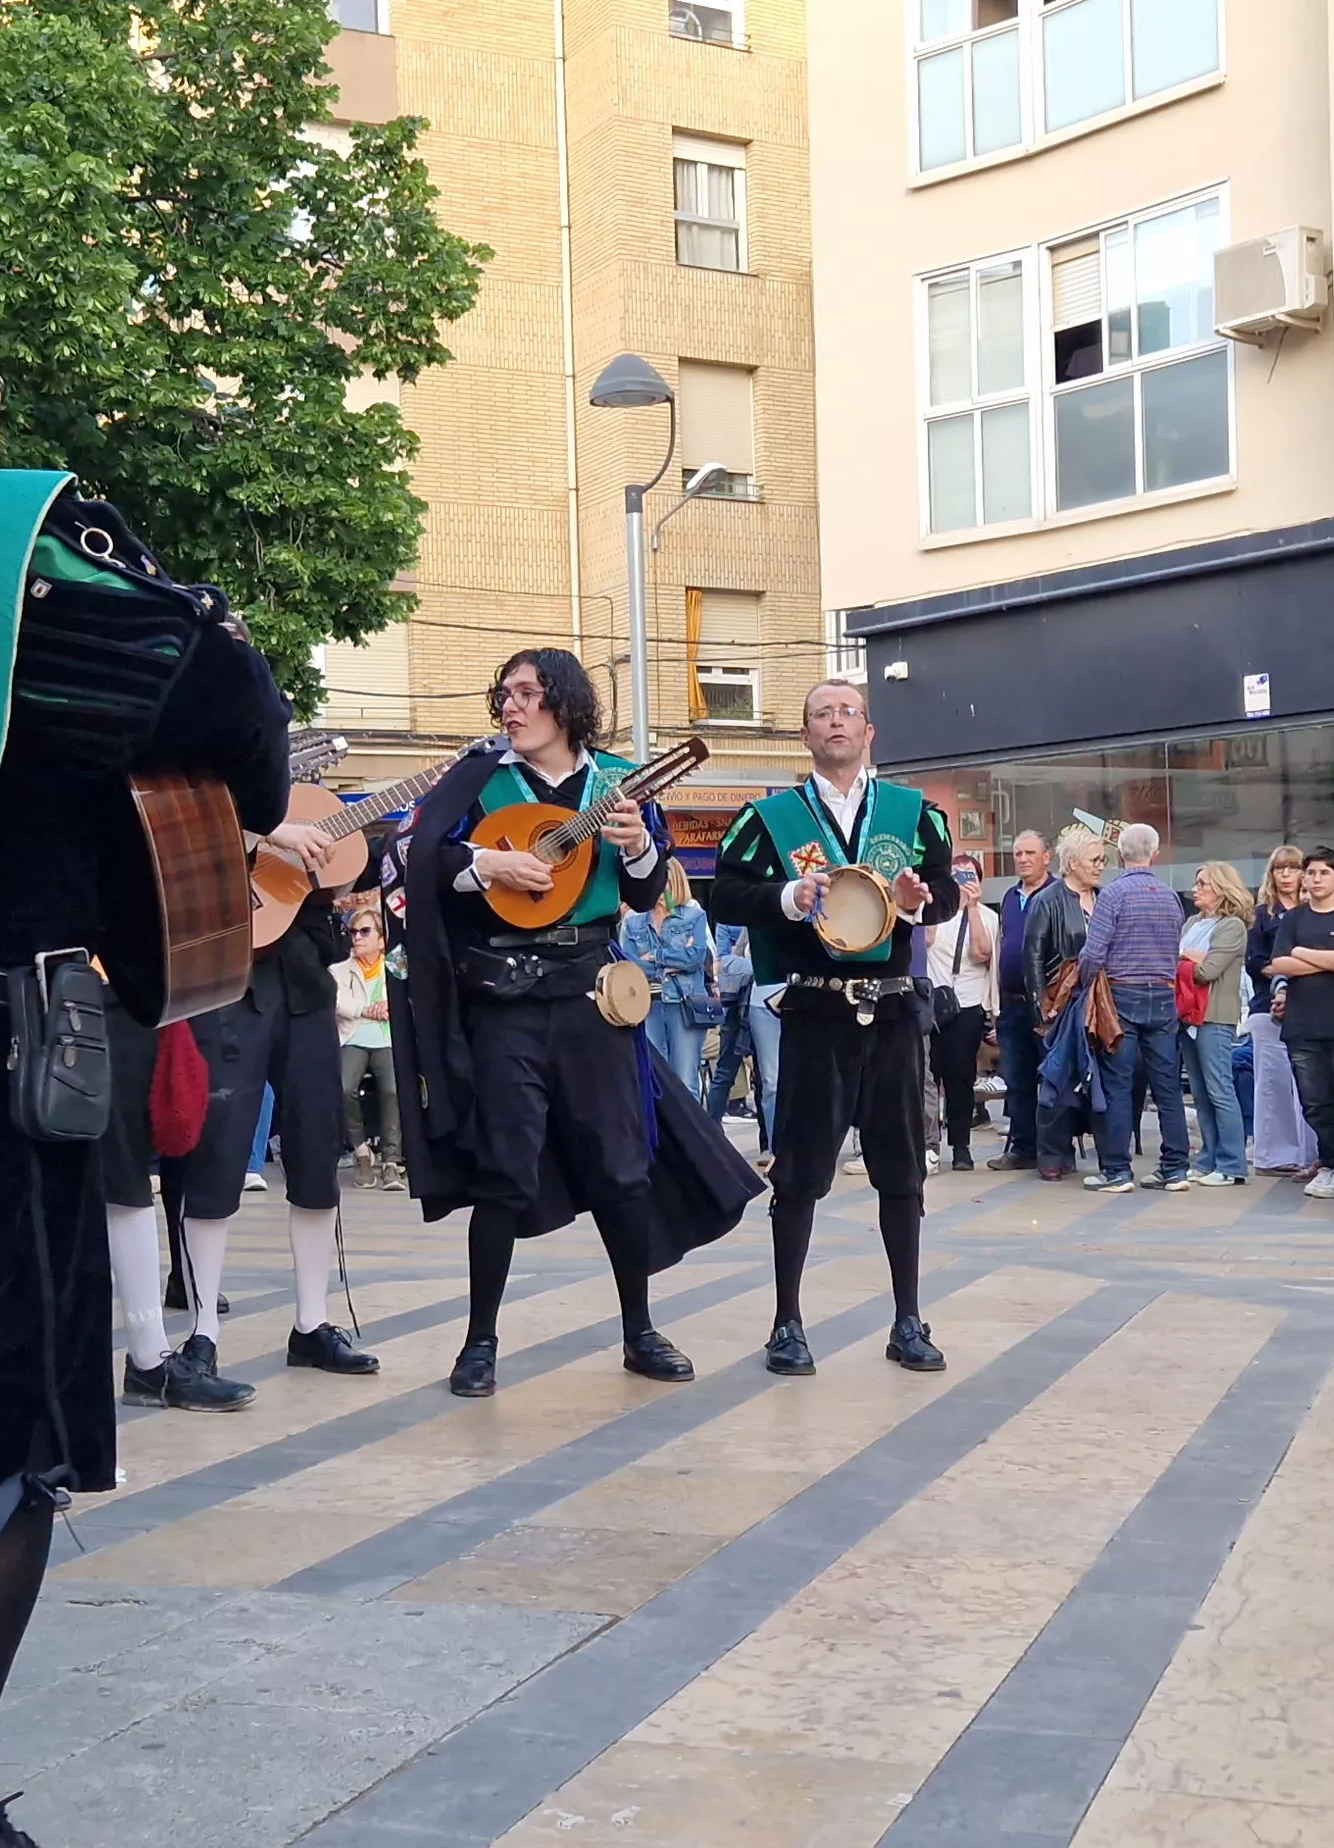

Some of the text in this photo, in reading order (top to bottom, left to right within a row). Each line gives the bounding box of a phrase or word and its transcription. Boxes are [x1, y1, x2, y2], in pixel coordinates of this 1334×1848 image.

[693, 792, 716, 801] PAGO
[717, 792, 729, 801] DE
[731, 792, 761, 802] DINERO
